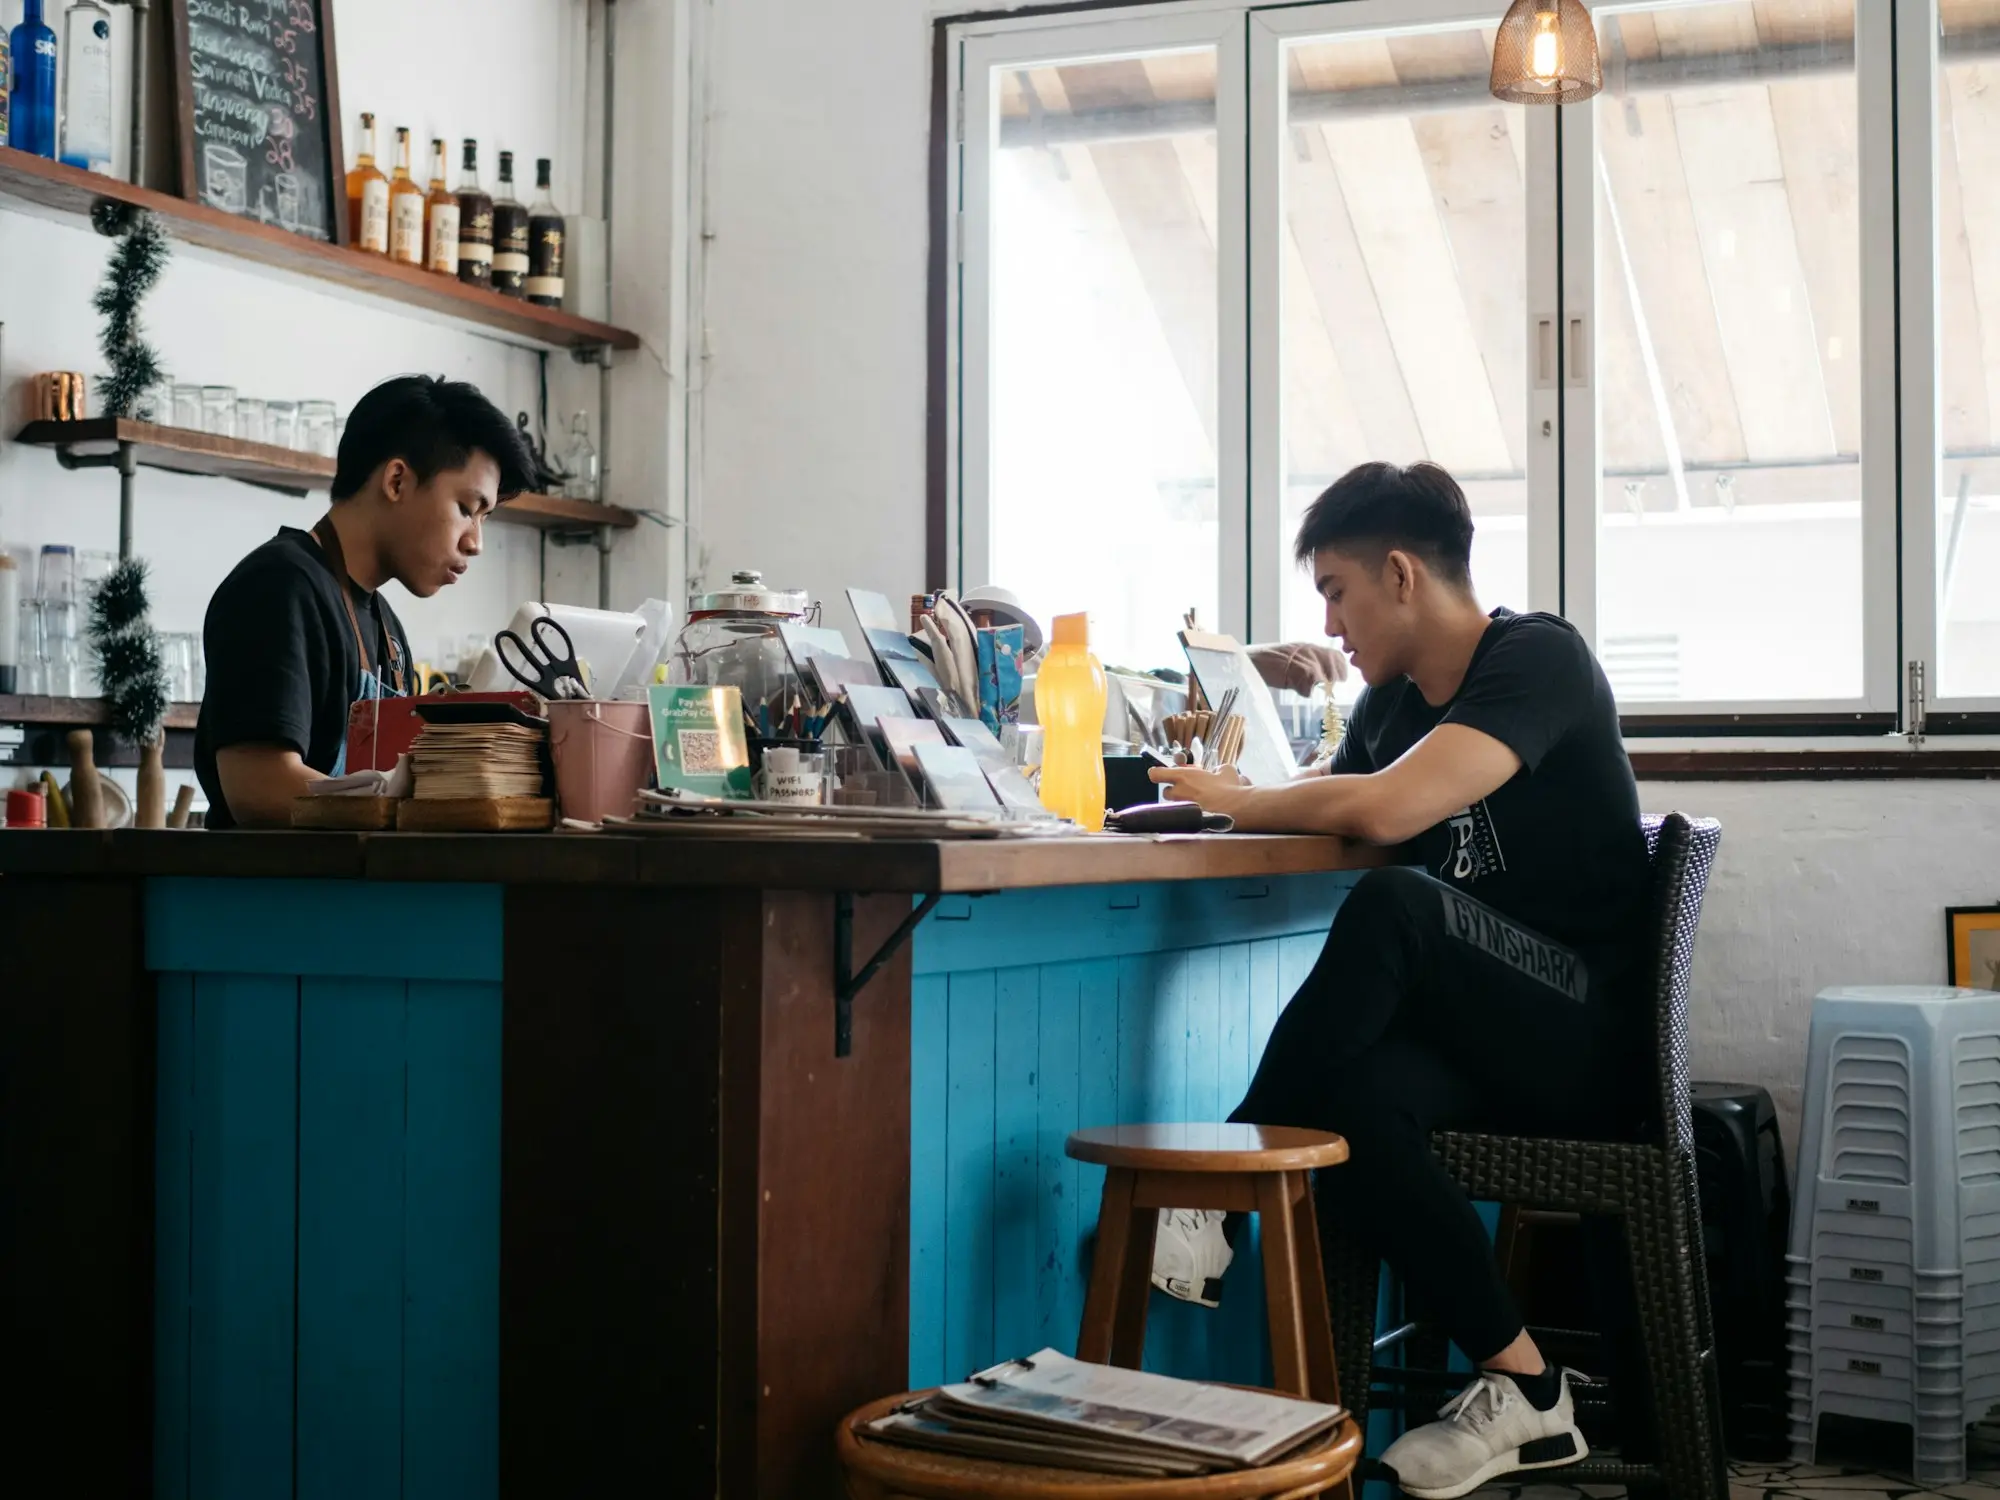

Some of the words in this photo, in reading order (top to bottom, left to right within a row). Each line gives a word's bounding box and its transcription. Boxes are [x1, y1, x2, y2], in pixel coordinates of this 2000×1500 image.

[678, 698, 694, 708] Pay
[661, 707, 698, 719] GrabPay
[776, 776, 802, 785] WIFI
[770, 786, 815, 798] PASSWORD
[1453, 901, 1577, 999] GYMSHARK
